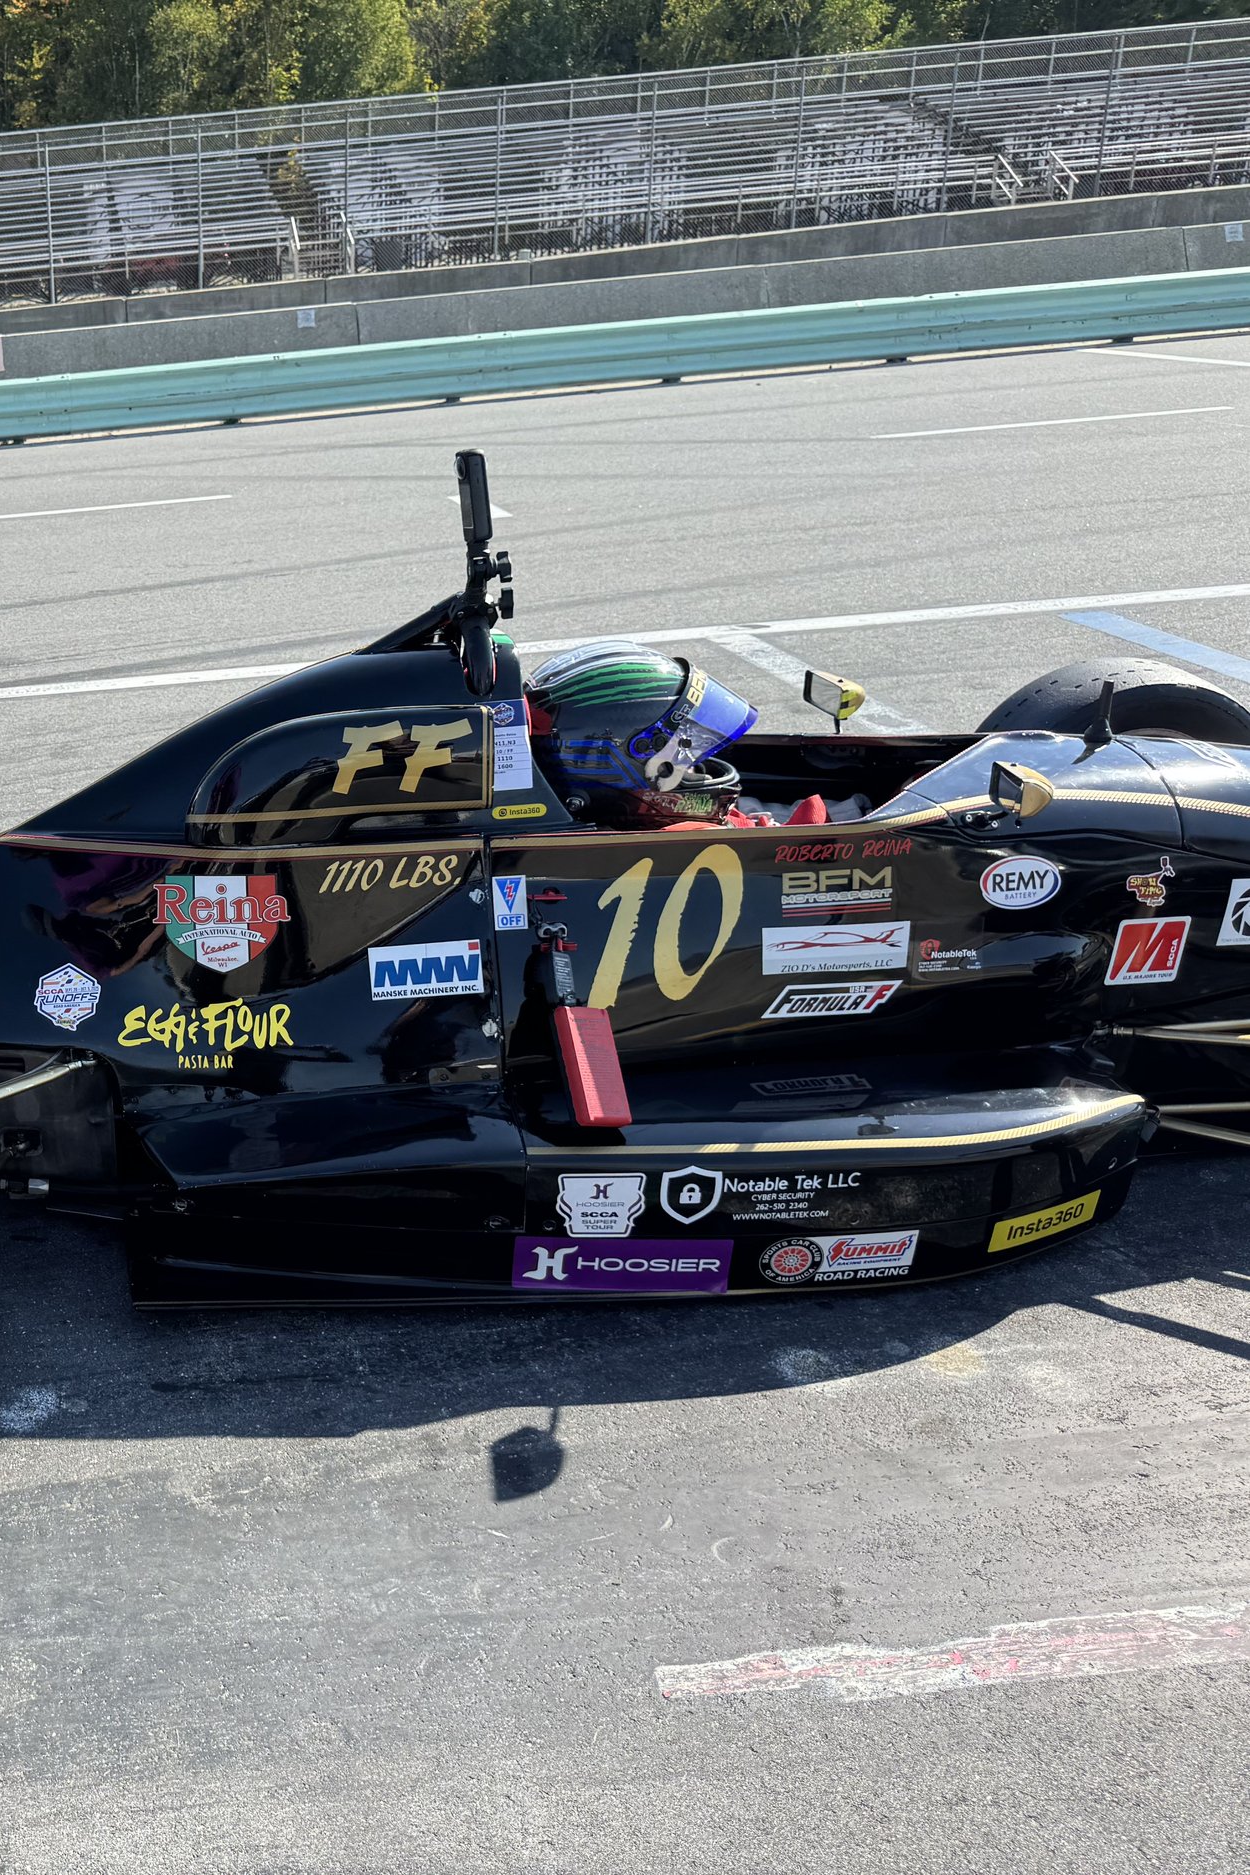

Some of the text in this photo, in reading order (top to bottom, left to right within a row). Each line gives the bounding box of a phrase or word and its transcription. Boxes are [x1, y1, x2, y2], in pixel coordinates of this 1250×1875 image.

[332, 718, 473, 795] FF
[509, 807, 541, 816] Insta360
[775, 837, 913, 864] ROBERTO REINA
[318, 854, 462, 894] 1110 LBS.
[782, 866, 892, 894] BFM
[992, 868, 1051, 893] REMY
[781, 888, 893, 904] MOTORSPORT
[1004, 890, 1037, 900] BATTERY
[152, 883, 291, 925] Reina
[501, 916, 522, 926] OFF
[587, 843, 743, 1010] 10
[184, 928, 258, 940] INTERNATIONAL AUTO
[200, 941, 241, 956] Vespa
[931, 949, 977, 959] NotableTek
[1166, 938, 1179, 967] SCCA
[818, 962, 872, 973] Motorsports,
[874, 959, 893, 967] LLC
[372, 990, 408, 998] MANSKE
[410, 986, 458, 996] MACHINERY
[850, 985, 865, 993] USA
[36, 992, 99, 1005] RUNOFFS
[770, 984, 894, 1014] FORMULA F
[200, 997, 294, 1051] FLOUR
[178, 1055, 234, 1069] PASTA BAR
[723, 1172, 861, 1193] Notable Tek LLC
[751, 1191, 815, 1201] CYBER SECURITY
[755, 1201, 808, 1211] 262-510 2340
[1006, 1202, 1085, 1240] Insta360
[762, 1239, 821, 1263] SPORTS CAR CLUB
[577, 1256, 721, 1273] HOOSIER
[765, 1269, 776, 1278] OF
[814, 1266, 910, 1281] ROAD RACING
